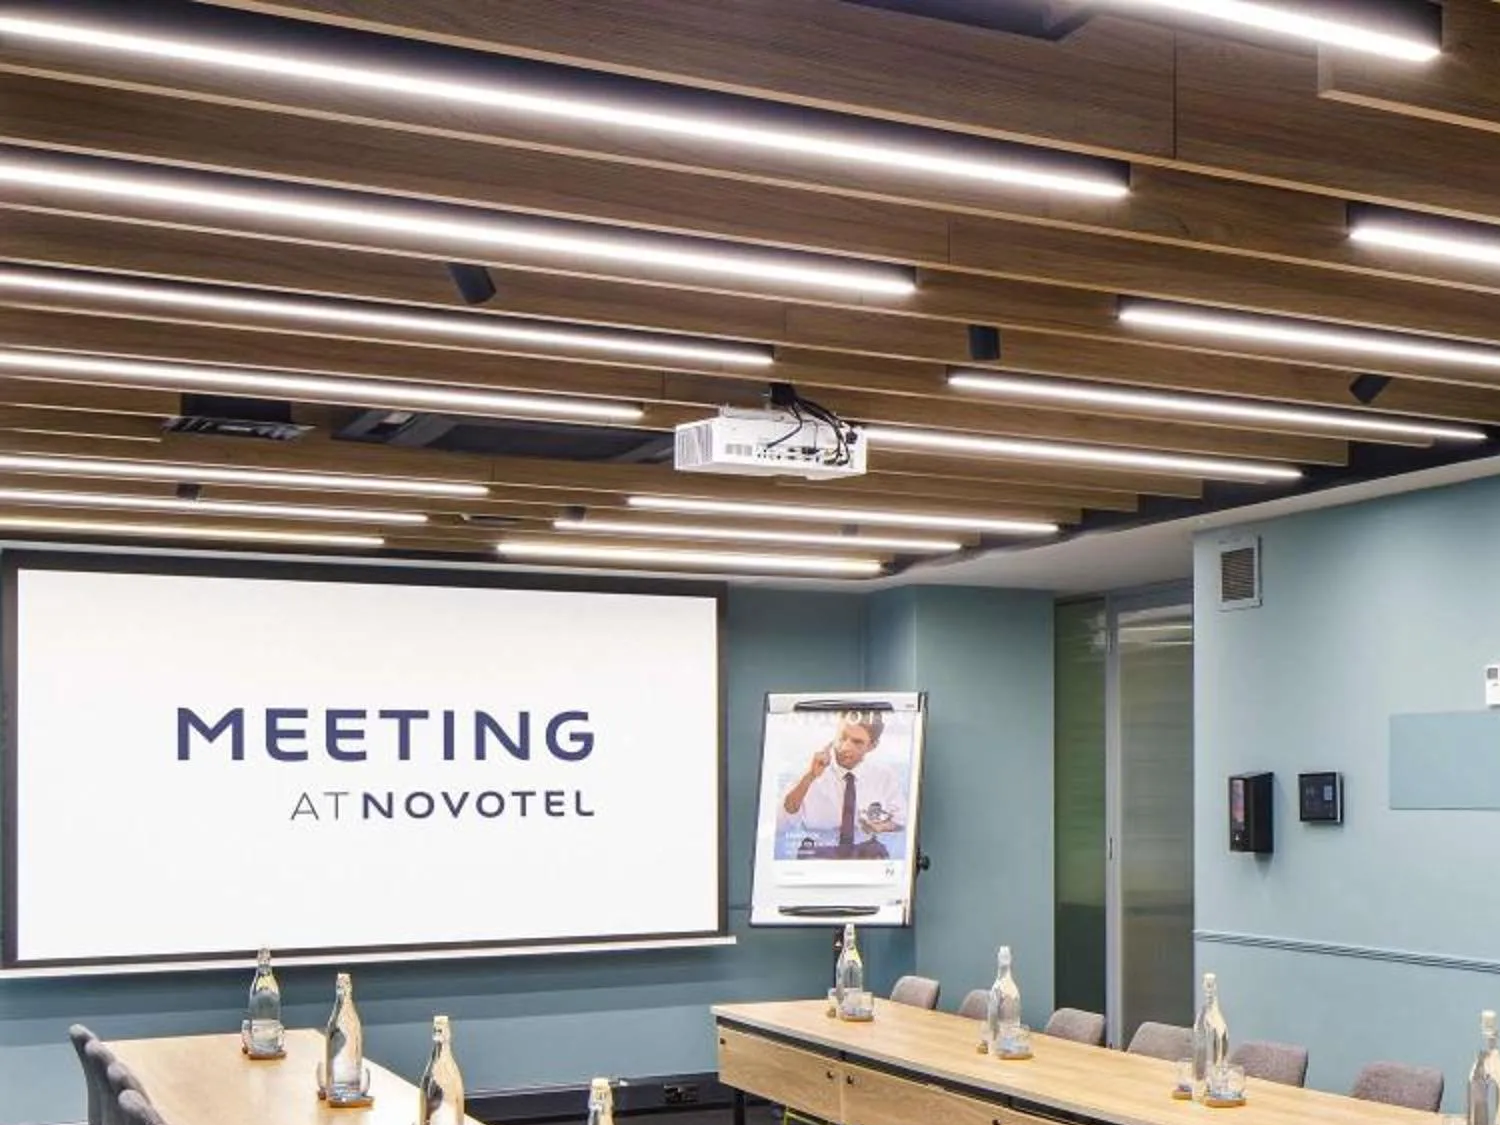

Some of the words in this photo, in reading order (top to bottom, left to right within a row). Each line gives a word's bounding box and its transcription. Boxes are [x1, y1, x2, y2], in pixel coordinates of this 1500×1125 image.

[177, 707, 594, 762] MEETING
[290, 791, 350, 821] AT
[362, 790, 595, 820] NOVOTEL
